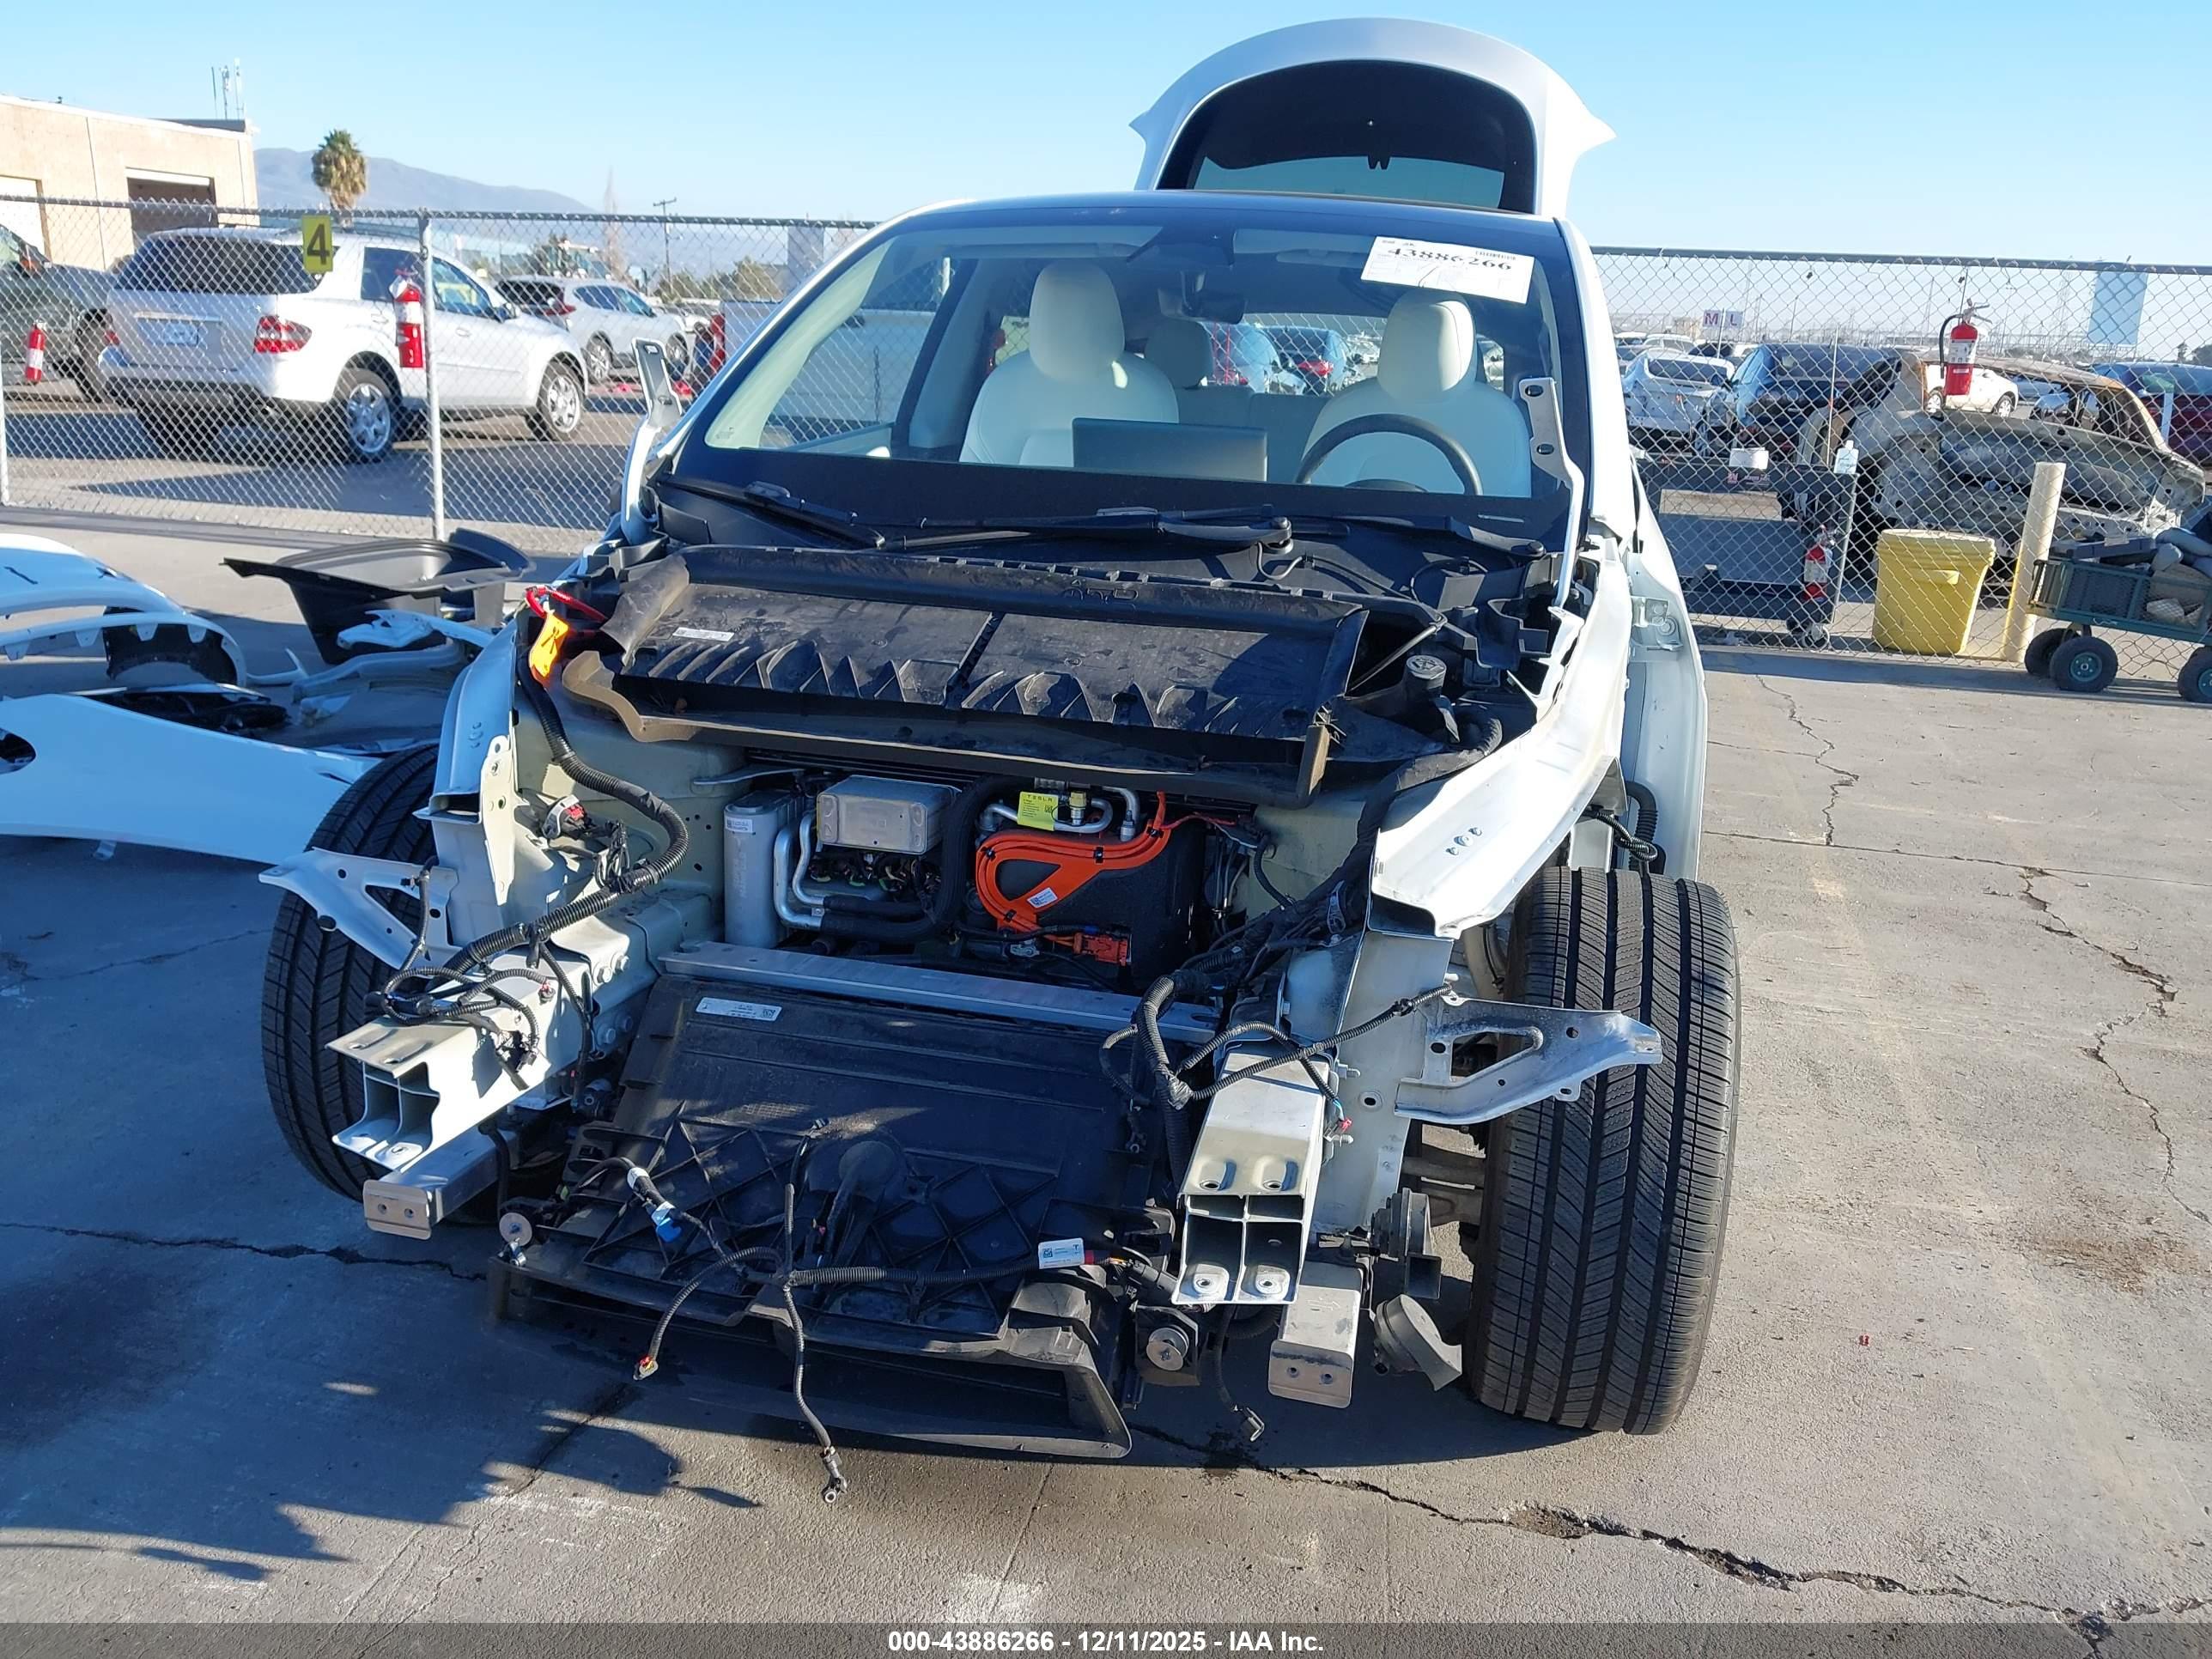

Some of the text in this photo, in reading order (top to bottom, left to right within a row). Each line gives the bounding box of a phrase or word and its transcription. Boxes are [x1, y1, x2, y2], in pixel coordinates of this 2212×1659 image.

[307, 223, 331, 265] 4
[1705, 313, 1719, 325] M
[1729, 313, 1738, 326] L
